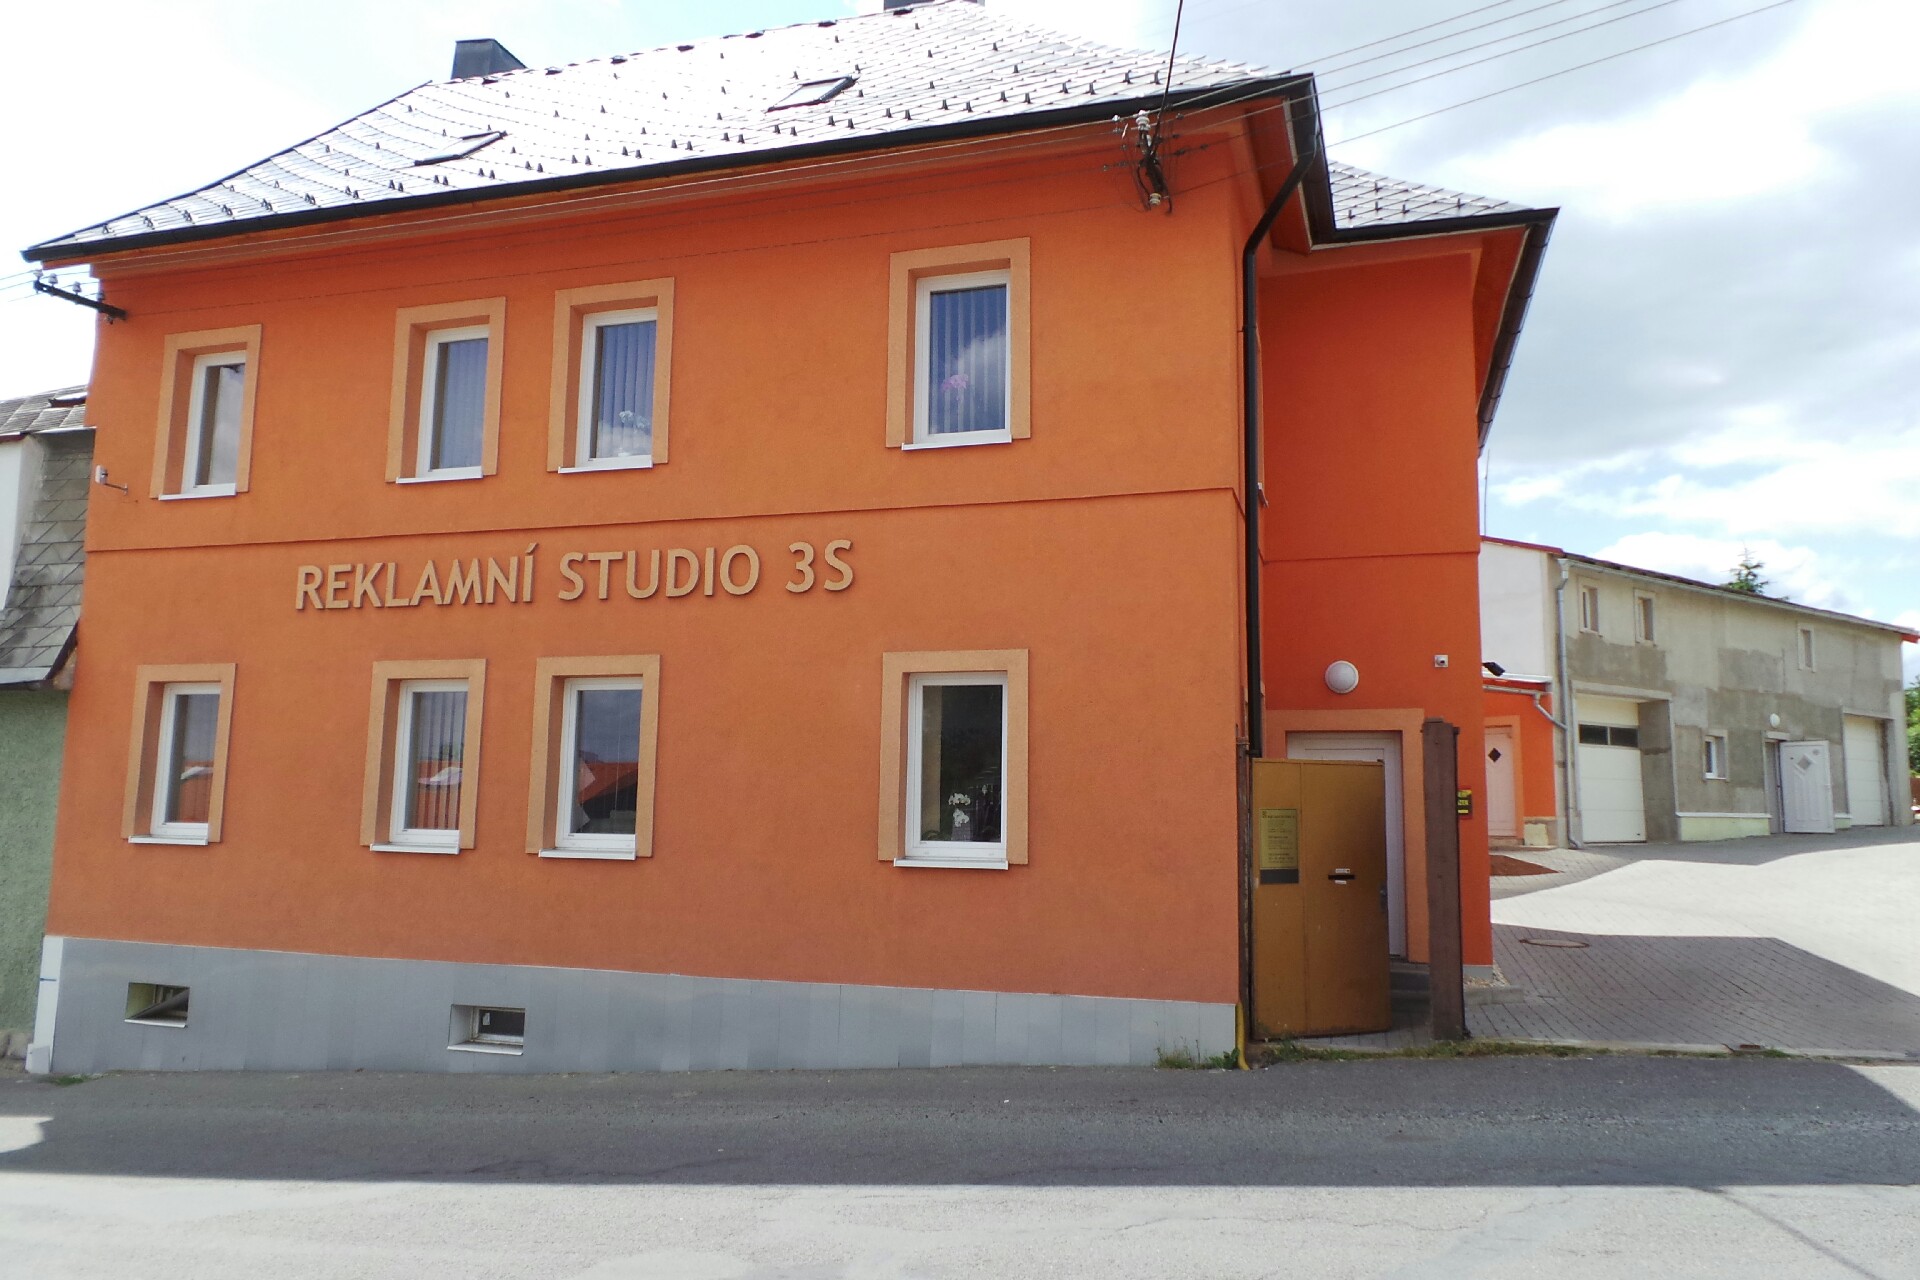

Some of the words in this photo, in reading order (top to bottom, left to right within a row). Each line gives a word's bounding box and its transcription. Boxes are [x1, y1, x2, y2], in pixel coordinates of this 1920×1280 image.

[295, 543, 538, 610] REKLAMNÍ
[558, 544, 760, 600] STUDIO
[786, 539, 853, 593] 3S
